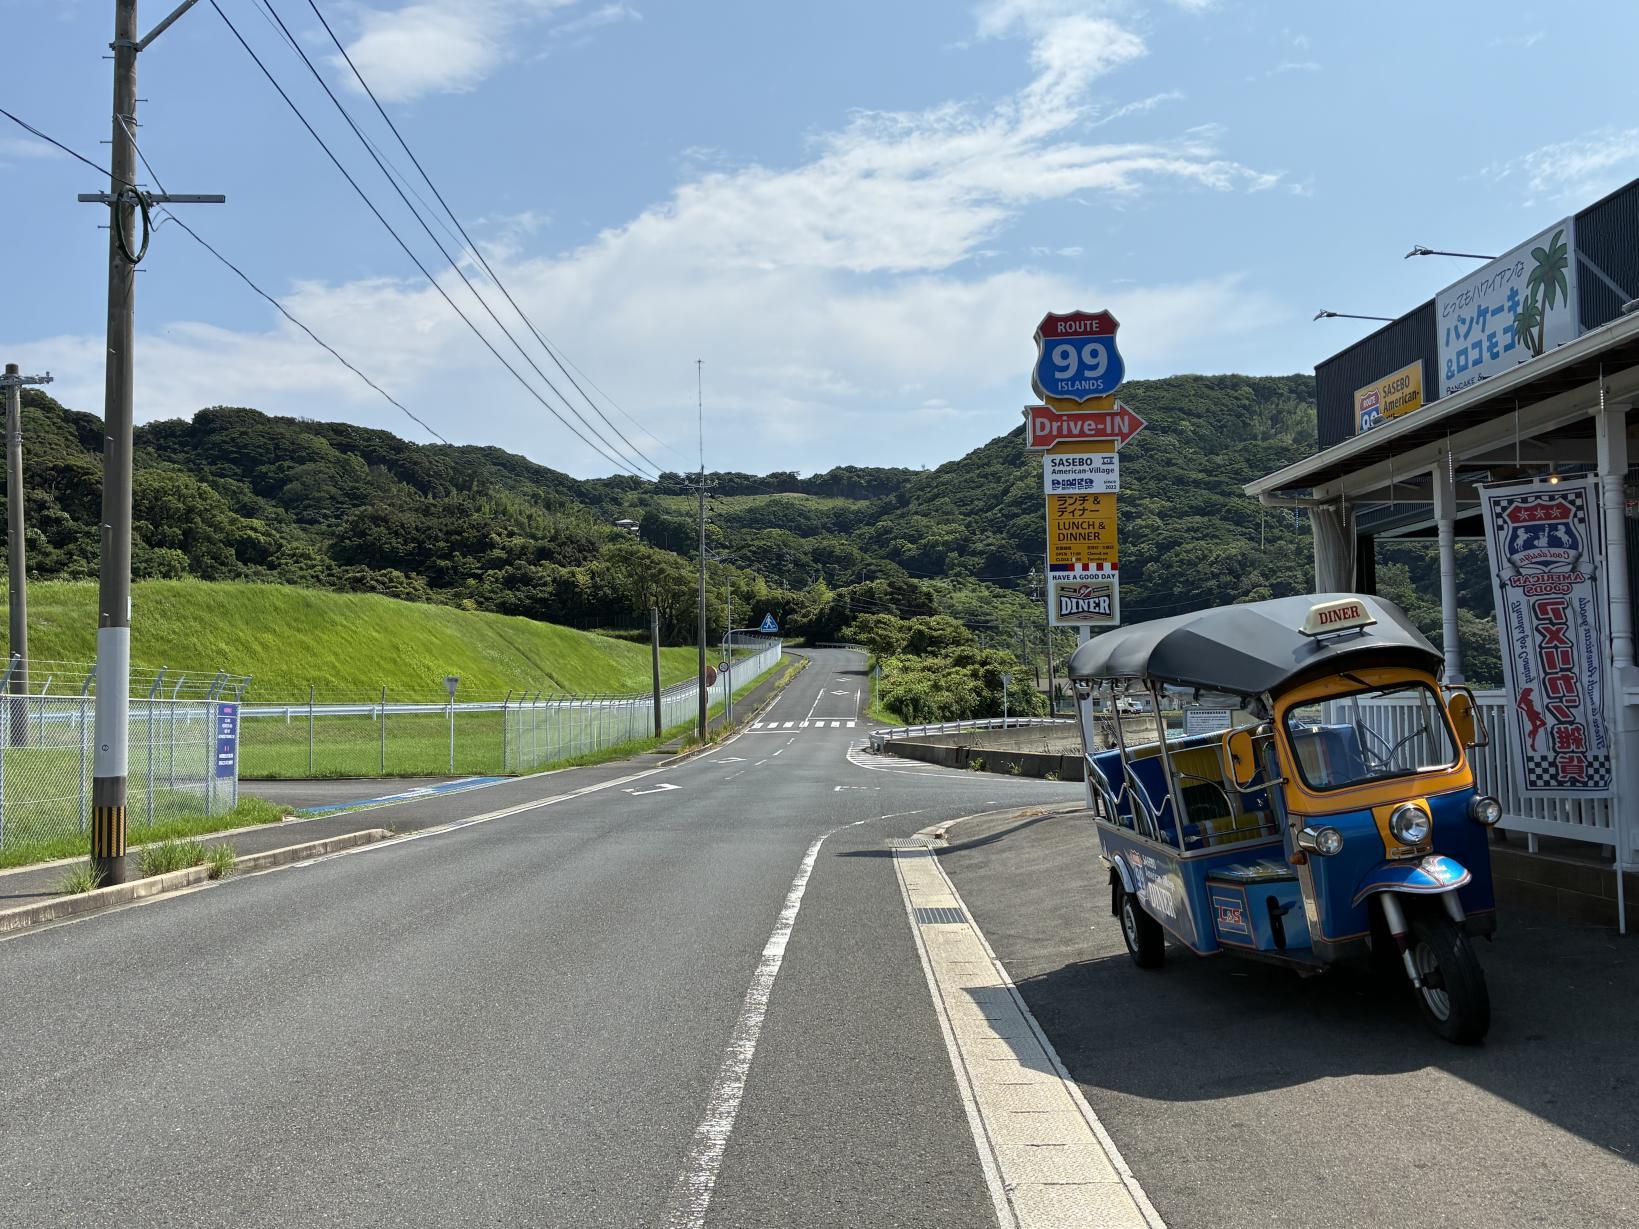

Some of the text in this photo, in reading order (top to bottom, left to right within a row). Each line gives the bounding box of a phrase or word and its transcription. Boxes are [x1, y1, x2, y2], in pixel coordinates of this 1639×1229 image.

[1442, 260, 1524, 318] とってもハワイアンな
[1445, 286, 1521, 347] パンケーキ
[1057, 320, 1100, 333] ROUTE
[1052, 343, 1108, 379] 99
[1445, 322, 1518, 381] &ロコモコ
[1058, 379, 1104, 391] ISLANDS
[1382, 374, 1410, 398] SASEBO
[1446, 377, 1476, 395] PANCAKE
[1383, 390, 1420, 413] American-
[1035, 415, 1129, 436] Drive-IN
[1051, 457, 1093, 467] SASEBO
[1051, 467, 1115, 475] American-Village
[1057, 496, 1101, 507] ランチ &
[1057, 521, 1106, 531] LUNCH &
[1057, 532, 1101, 542] DINNER
[1060, 596, 1111, 615] DINER
[1318, 605, 1361, 625] DINER
